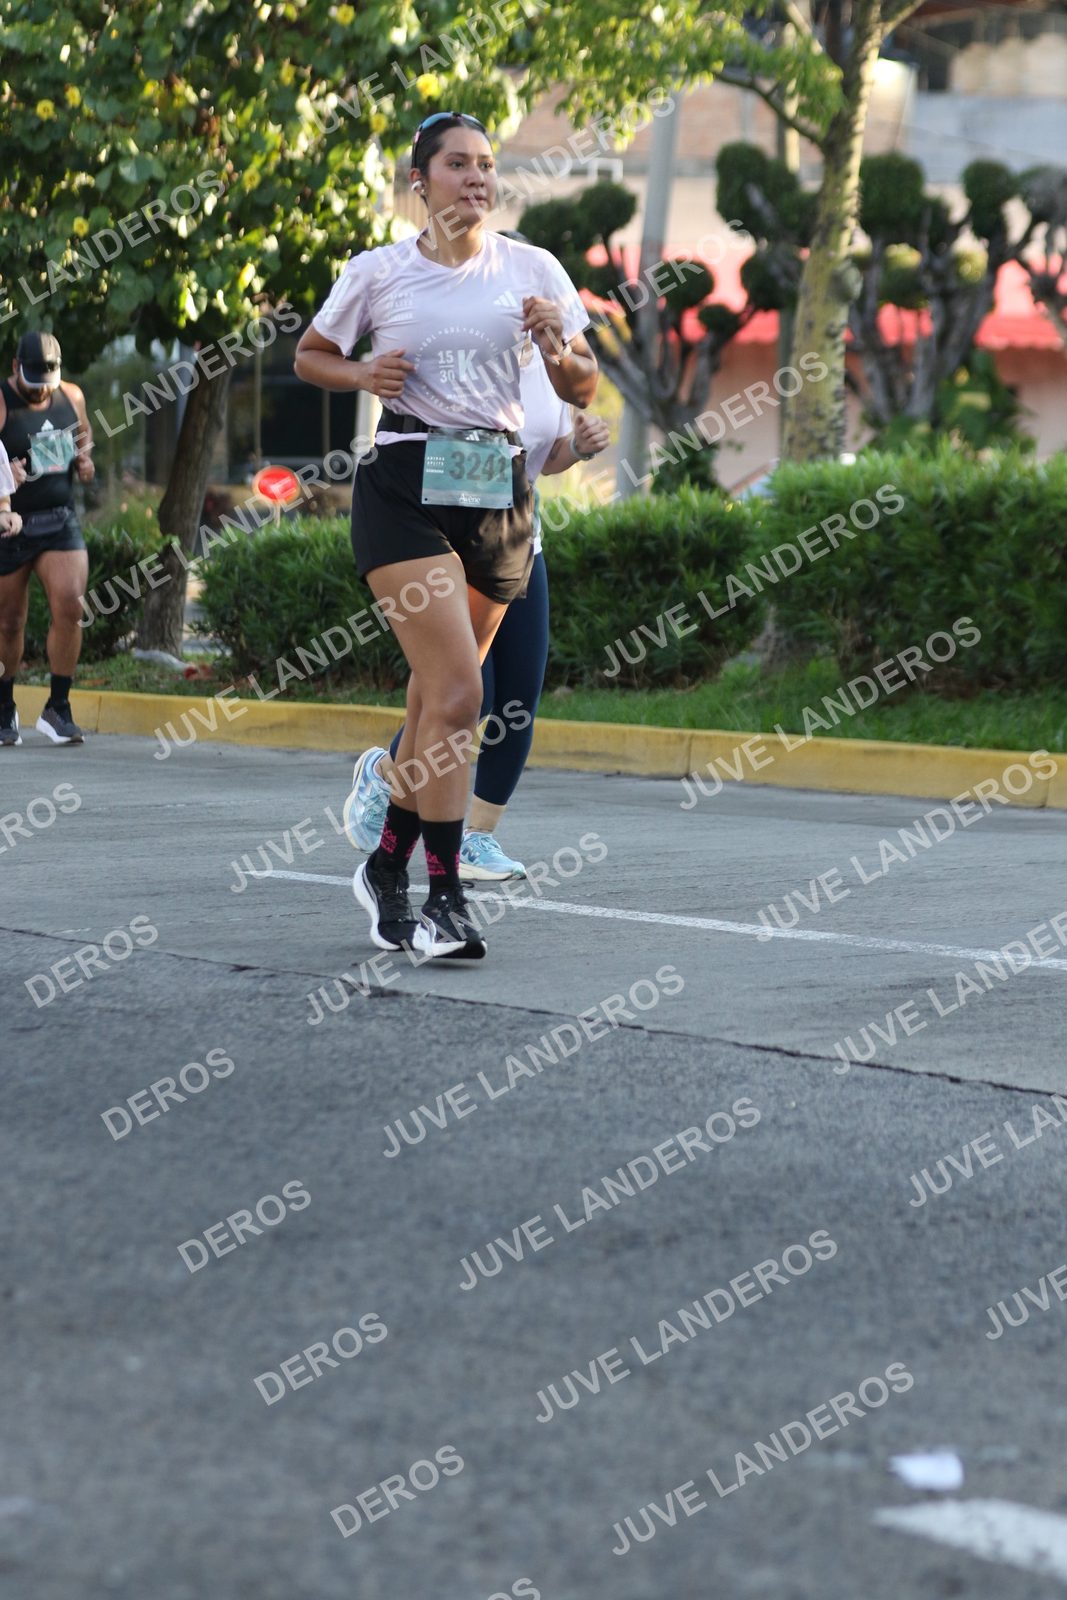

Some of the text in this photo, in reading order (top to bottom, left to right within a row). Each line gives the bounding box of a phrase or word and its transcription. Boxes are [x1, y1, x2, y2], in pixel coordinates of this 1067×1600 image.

[437, 349, 454, 365] 15
[457, 348, 479, 383] K
[439, 369, 455, 384] 30
[448, 450, 509, 483] 3241
